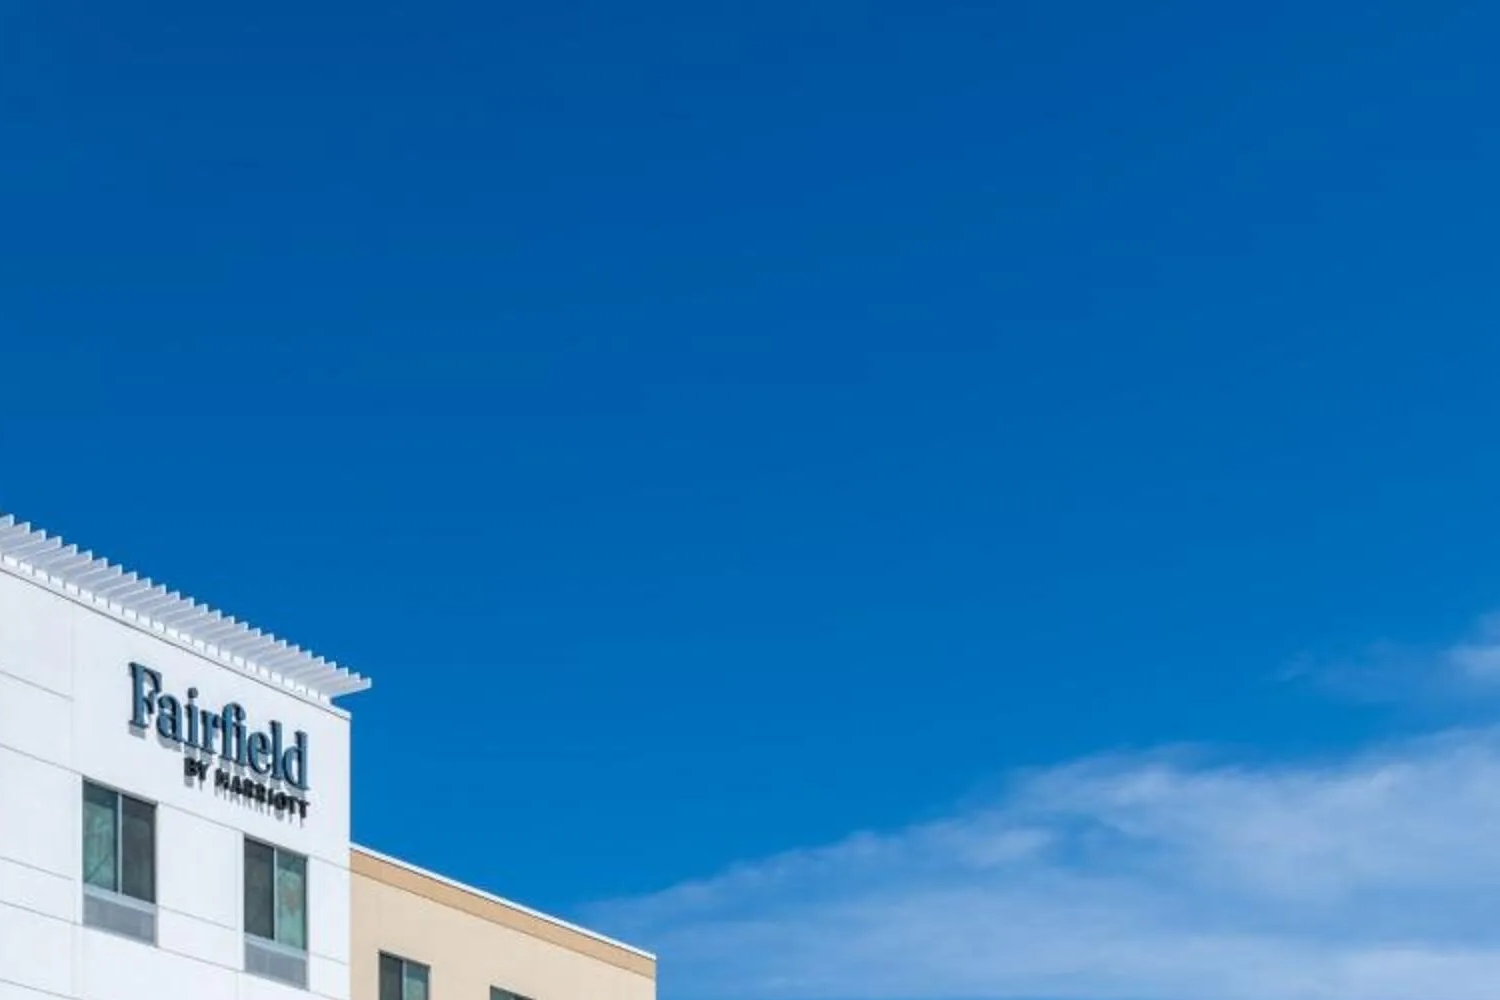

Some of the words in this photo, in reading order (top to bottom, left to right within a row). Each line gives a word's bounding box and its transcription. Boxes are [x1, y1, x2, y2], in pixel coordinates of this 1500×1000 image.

[128, 661, 310, 790] Fairfield
[184, 757, 209, 781] BY
[215, 768, 310, 818] MARRIOTT
